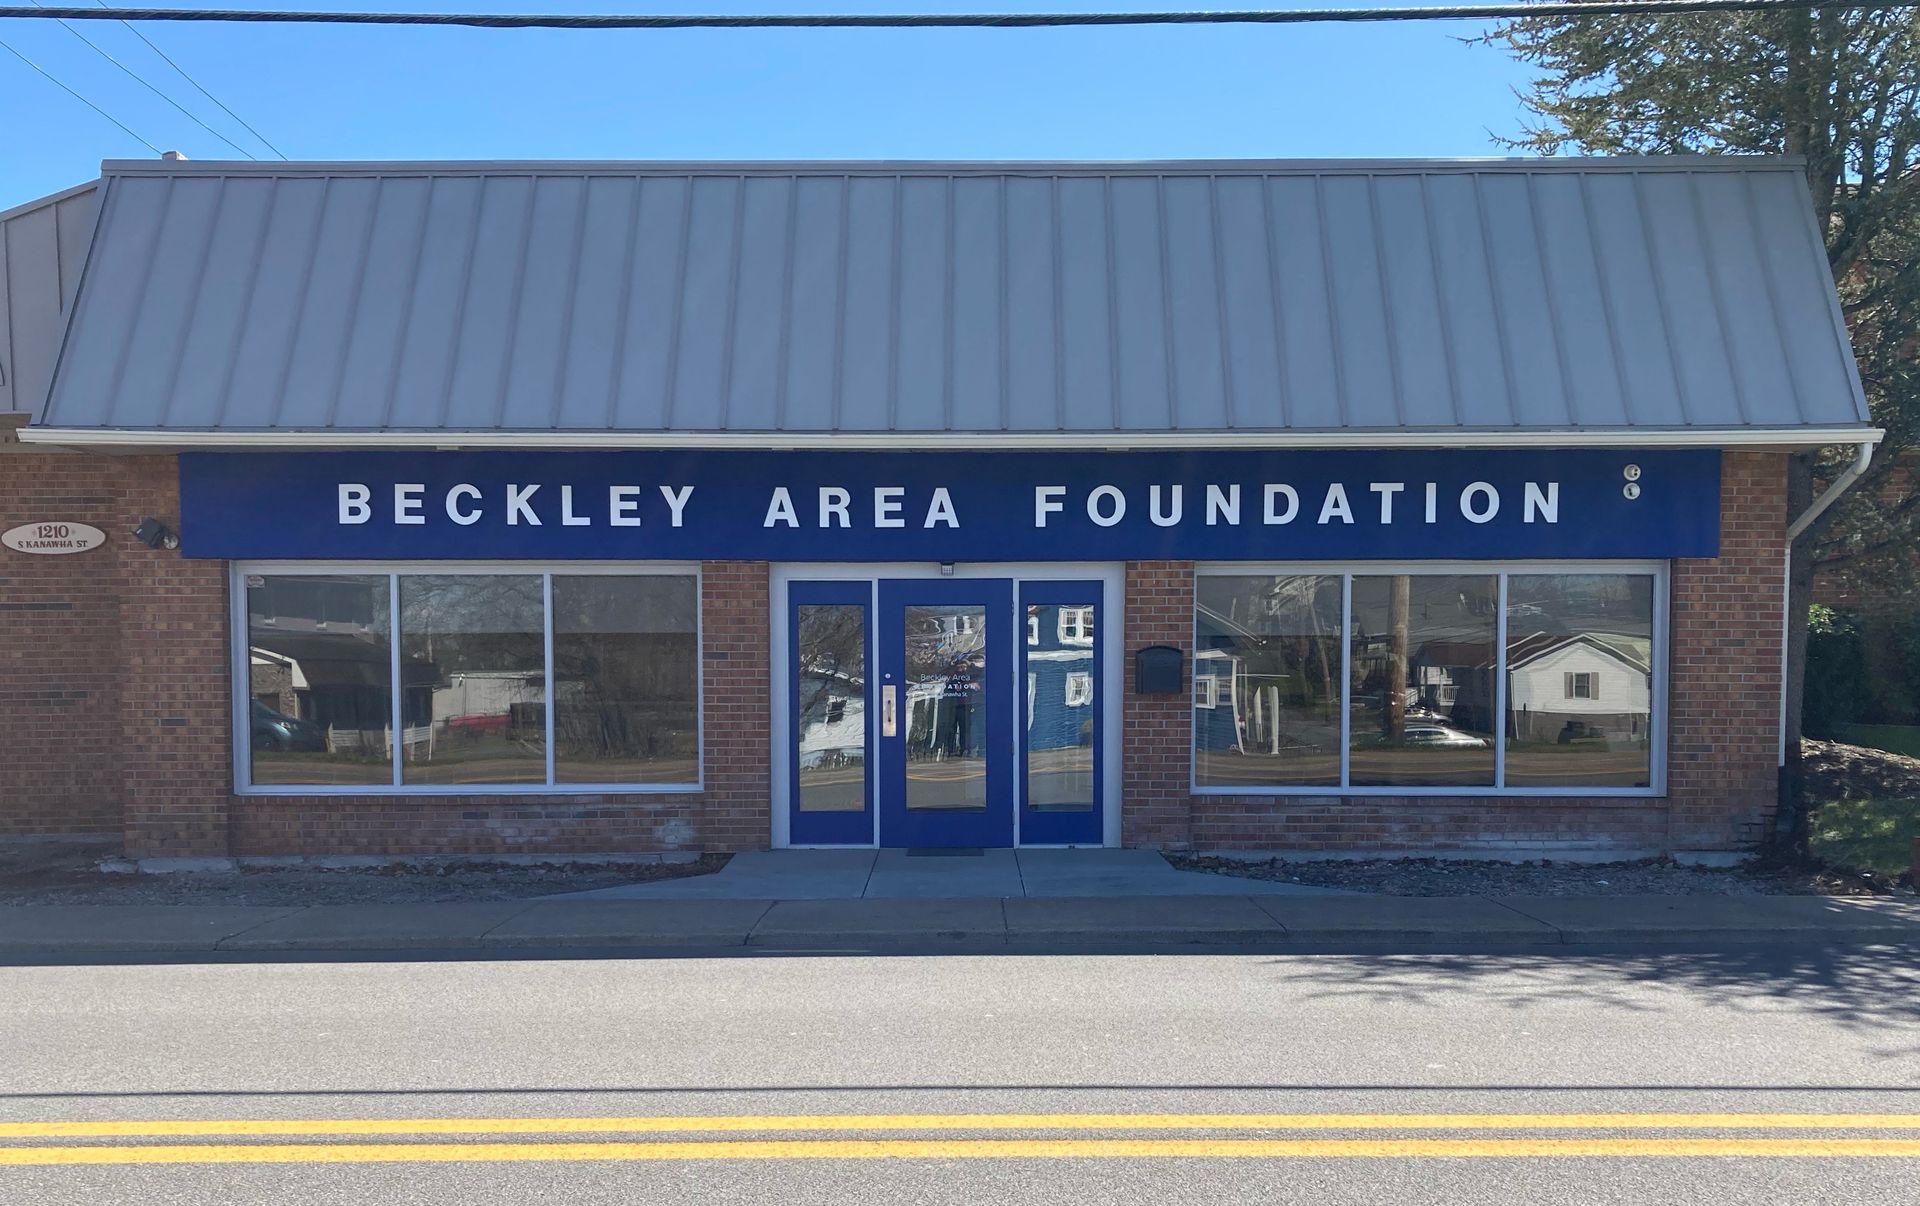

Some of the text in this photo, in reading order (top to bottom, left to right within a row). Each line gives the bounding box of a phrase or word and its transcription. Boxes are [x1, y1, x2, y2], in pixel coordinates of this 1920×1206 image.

[337, 481, 1560, 529] BECKLEY AREA FOUNDATION
[37, 524, 69, 539] 1210
[26, 540, 73, 548] KANAWHA
[952, 673, 971, 681] Area
